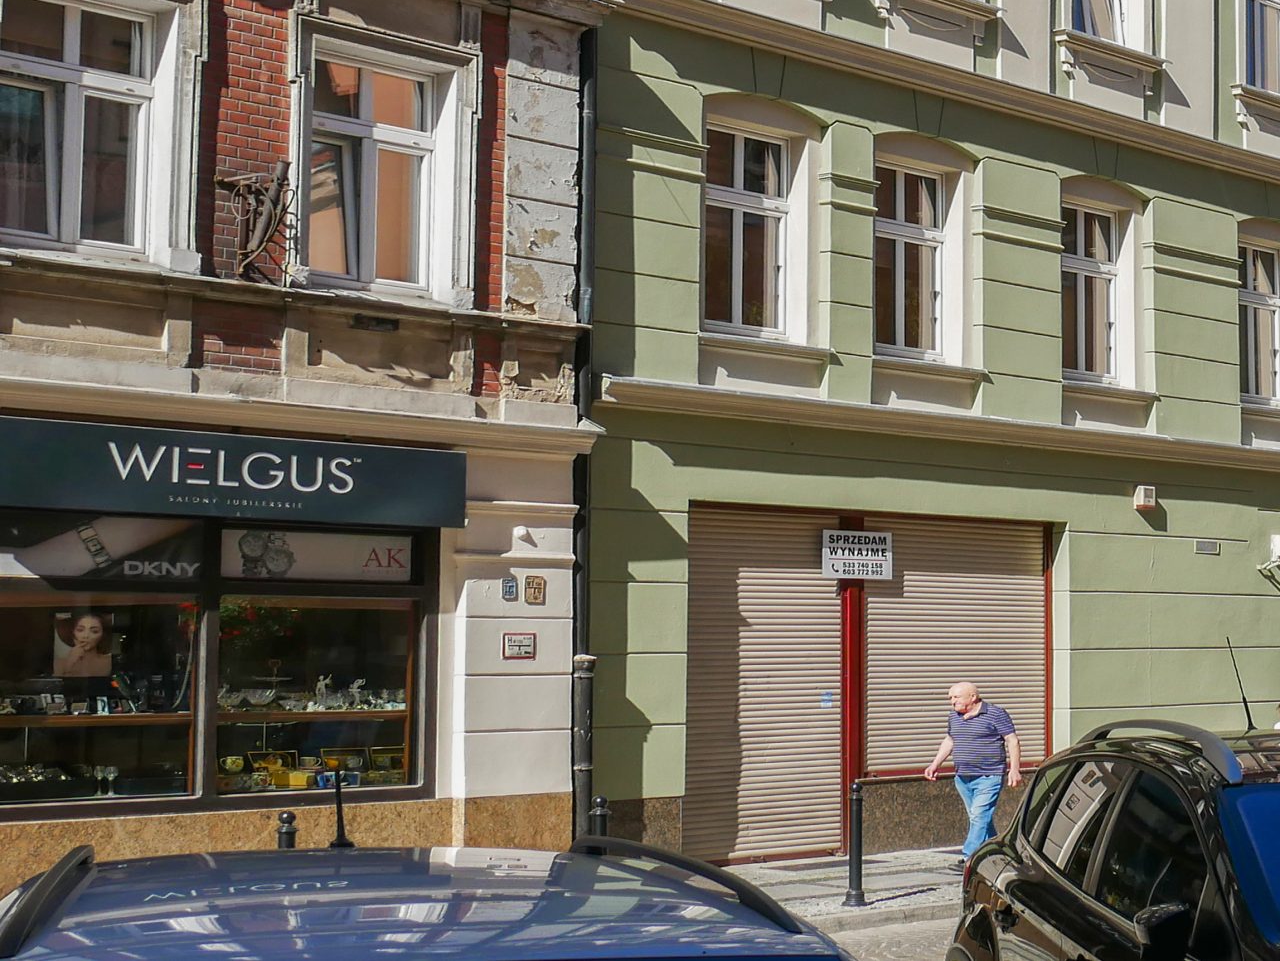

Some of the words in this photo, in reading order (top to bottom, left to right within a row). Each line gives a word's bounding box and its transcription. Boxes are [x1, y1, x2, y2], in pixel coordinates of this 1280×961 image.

[108, 441, 354, 494] WIELGUS
[828, 534, 887, 546] SPRZEDAM
[361, 547, 408, 569] AK
[123, 560, 201, 577] DKNY
